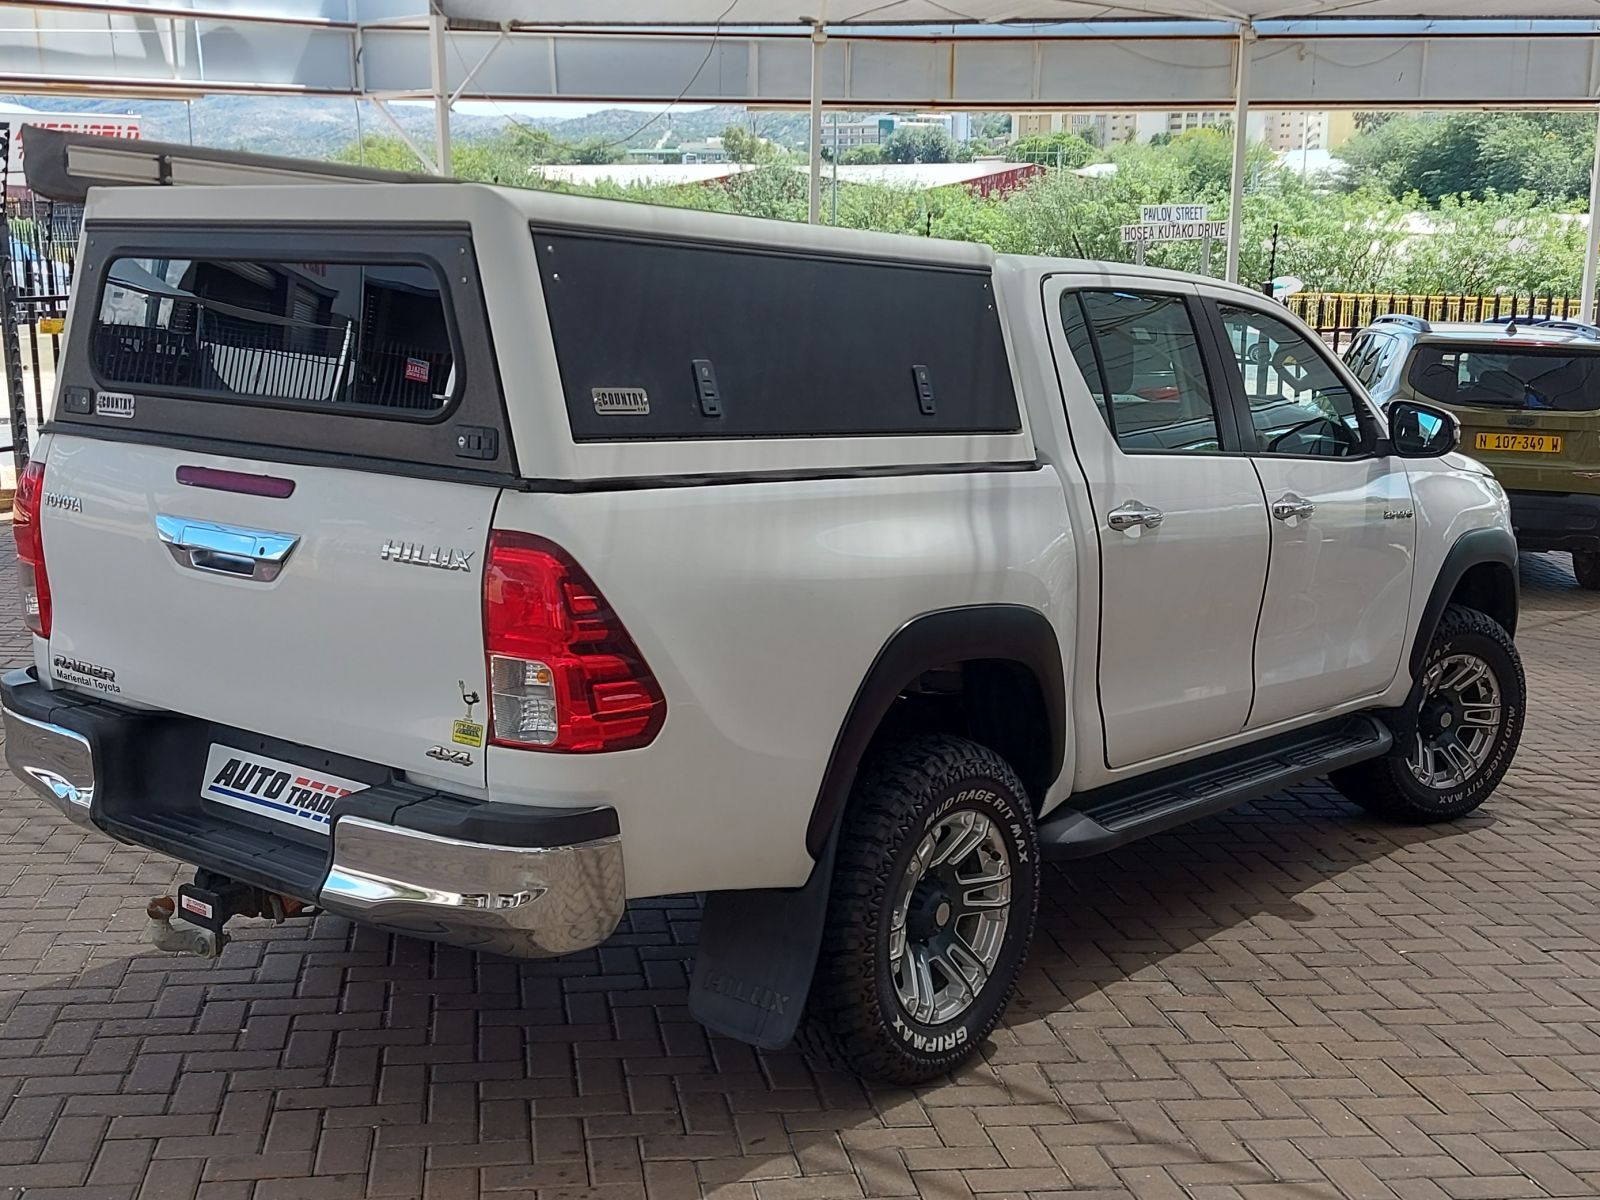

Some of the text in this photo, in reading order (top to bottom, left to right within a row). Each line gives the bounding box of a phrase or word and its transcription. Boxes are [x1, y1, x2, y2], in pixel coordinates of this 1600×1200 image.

[1143, 206, 1204, 222] PAVLOV STREET
[1124, 222, 1226, 241] HOSEA KUTAKO DRIVE
[102, 395, 132, 410] COUNTRY
[601, 392, 644, 406] COUNTRY
[1480, 436, 1487, 448] N
[1495, 435, 1545, 450] 107-349
[44, 492, 83, 513] TOYOTA
[381, 540, 475, 573] HILUX
[53, 654, 116, 682] RAIDER
[56, 669, 121, 693] Mariental Toyota
[1502, 705, 1516, 739] MUD
[1484, 740, 1508, 780] RAGE
[212, 758, 291, 800] AUTO
[1438, 792, 1464, 804] MAX
[923, 789, 1029, 864] MUD RAGE R/T MAX
[891, 1013, 968, 1053] GRIPMAX
